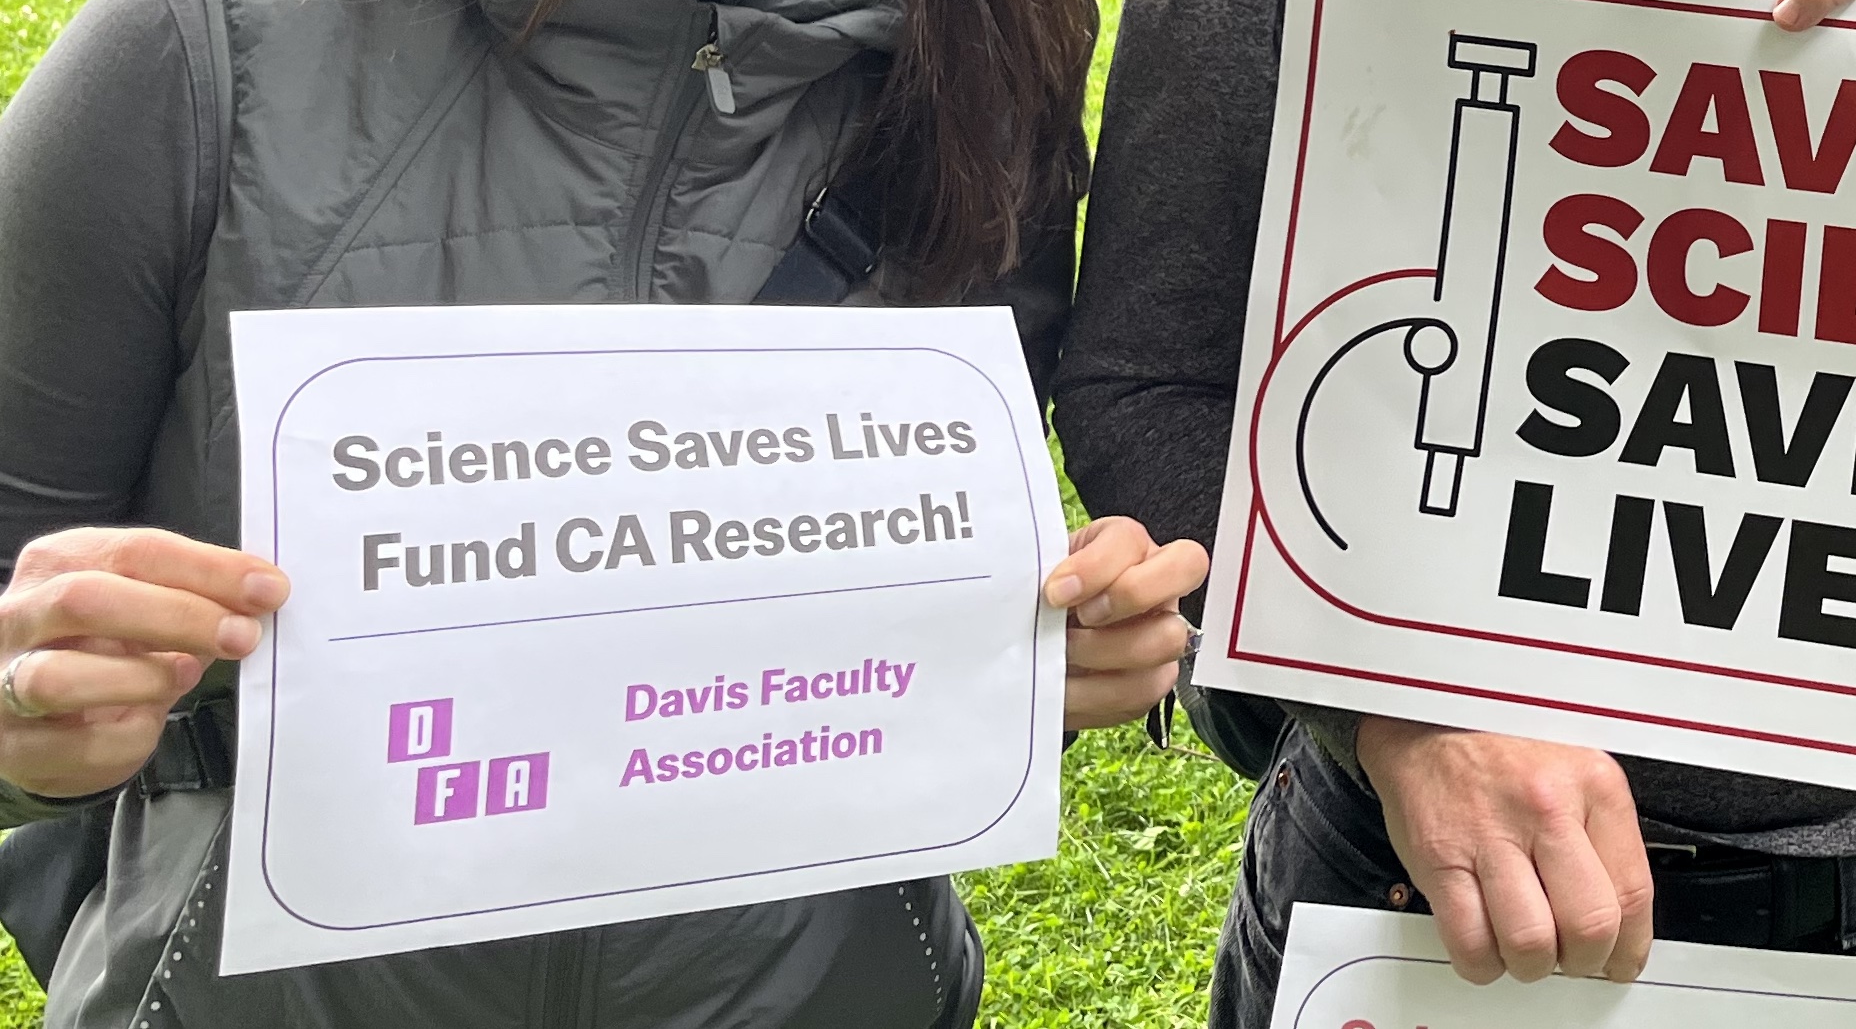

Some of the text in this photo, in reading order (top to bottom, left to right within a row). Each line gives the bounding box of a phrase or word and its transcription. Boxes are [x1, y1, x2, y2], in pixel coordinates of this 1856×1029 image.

[332, 413, 977, 491] Science Saves Lives
[362, 491, 974, 591] Fund CA Research!
[625, 658, 916, 721] Davis Faculty
[619, 727, 883, 786] Association
